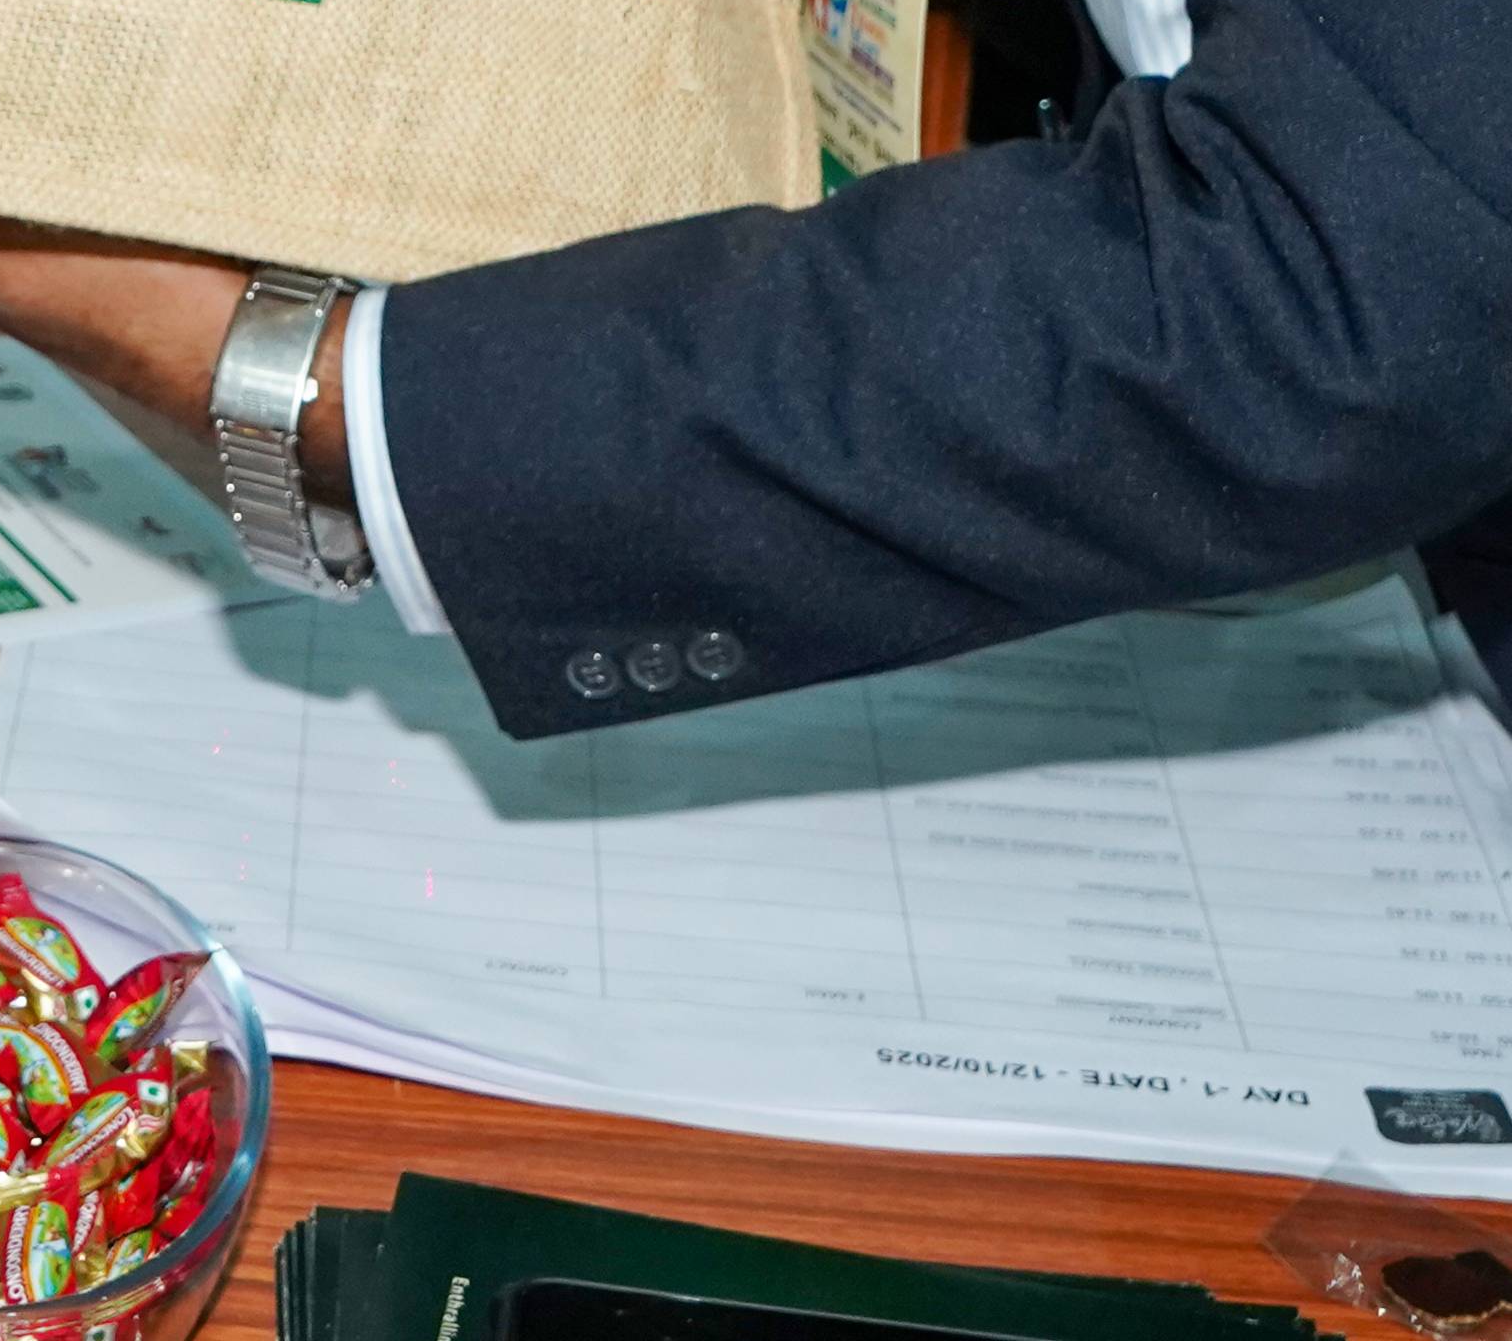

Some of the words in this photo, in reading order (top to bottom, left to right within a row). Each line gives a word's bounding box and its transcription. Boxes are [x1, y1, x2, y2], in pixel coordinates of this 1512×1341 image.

[875, 1046, 1046, 1081] 12/10/2025
[1080, 1068, 1170, 1093] DATE
[1242, 1086, 1311, 1107] DAY
